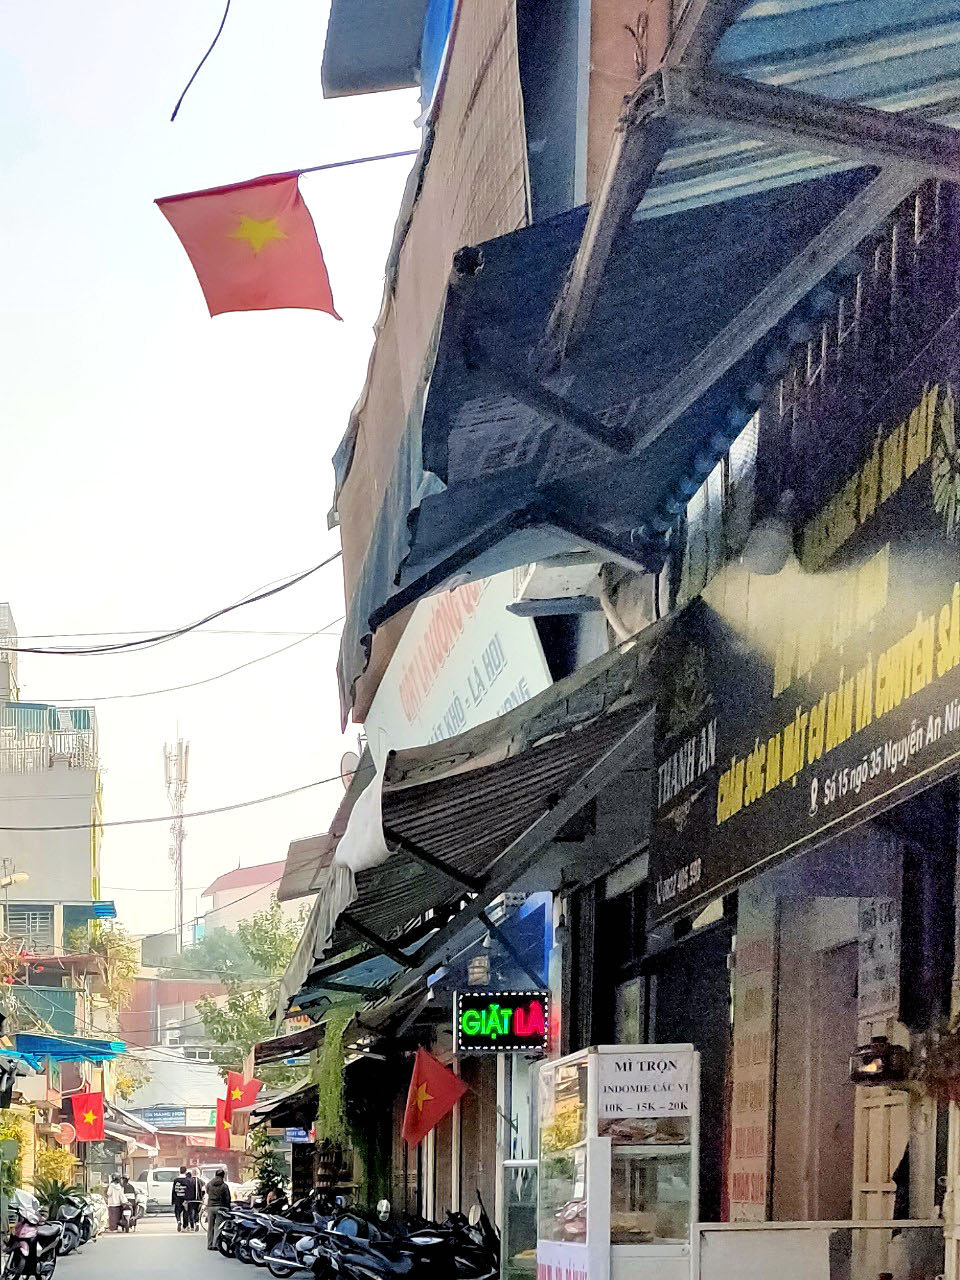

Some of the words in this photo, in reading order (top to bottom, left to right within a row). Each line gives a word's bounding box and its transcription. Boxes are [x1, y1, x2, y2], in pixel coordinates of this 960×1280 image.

[824, 769, 837, 806] Số
[838, 768, 850, 797] 15
[850, 755, 868, 793] ngõ
[869, 746, 882, 779] 35
[883, 719, 923, 773] Nguyễn
[925, 715, 941, 746] An
[462, 1003, 513, 1040] GIẶT
[615, 1058, 633, 1072] MÌ
[603, 1084, 651, 1094] INDOMIE
[653, 1080, 675, 1093] CÁC
[604, 1103, 624, 1112] 10K
[636, 1102, 657, 1112] 15K
[667, 1101, 689, 1111] 20K
